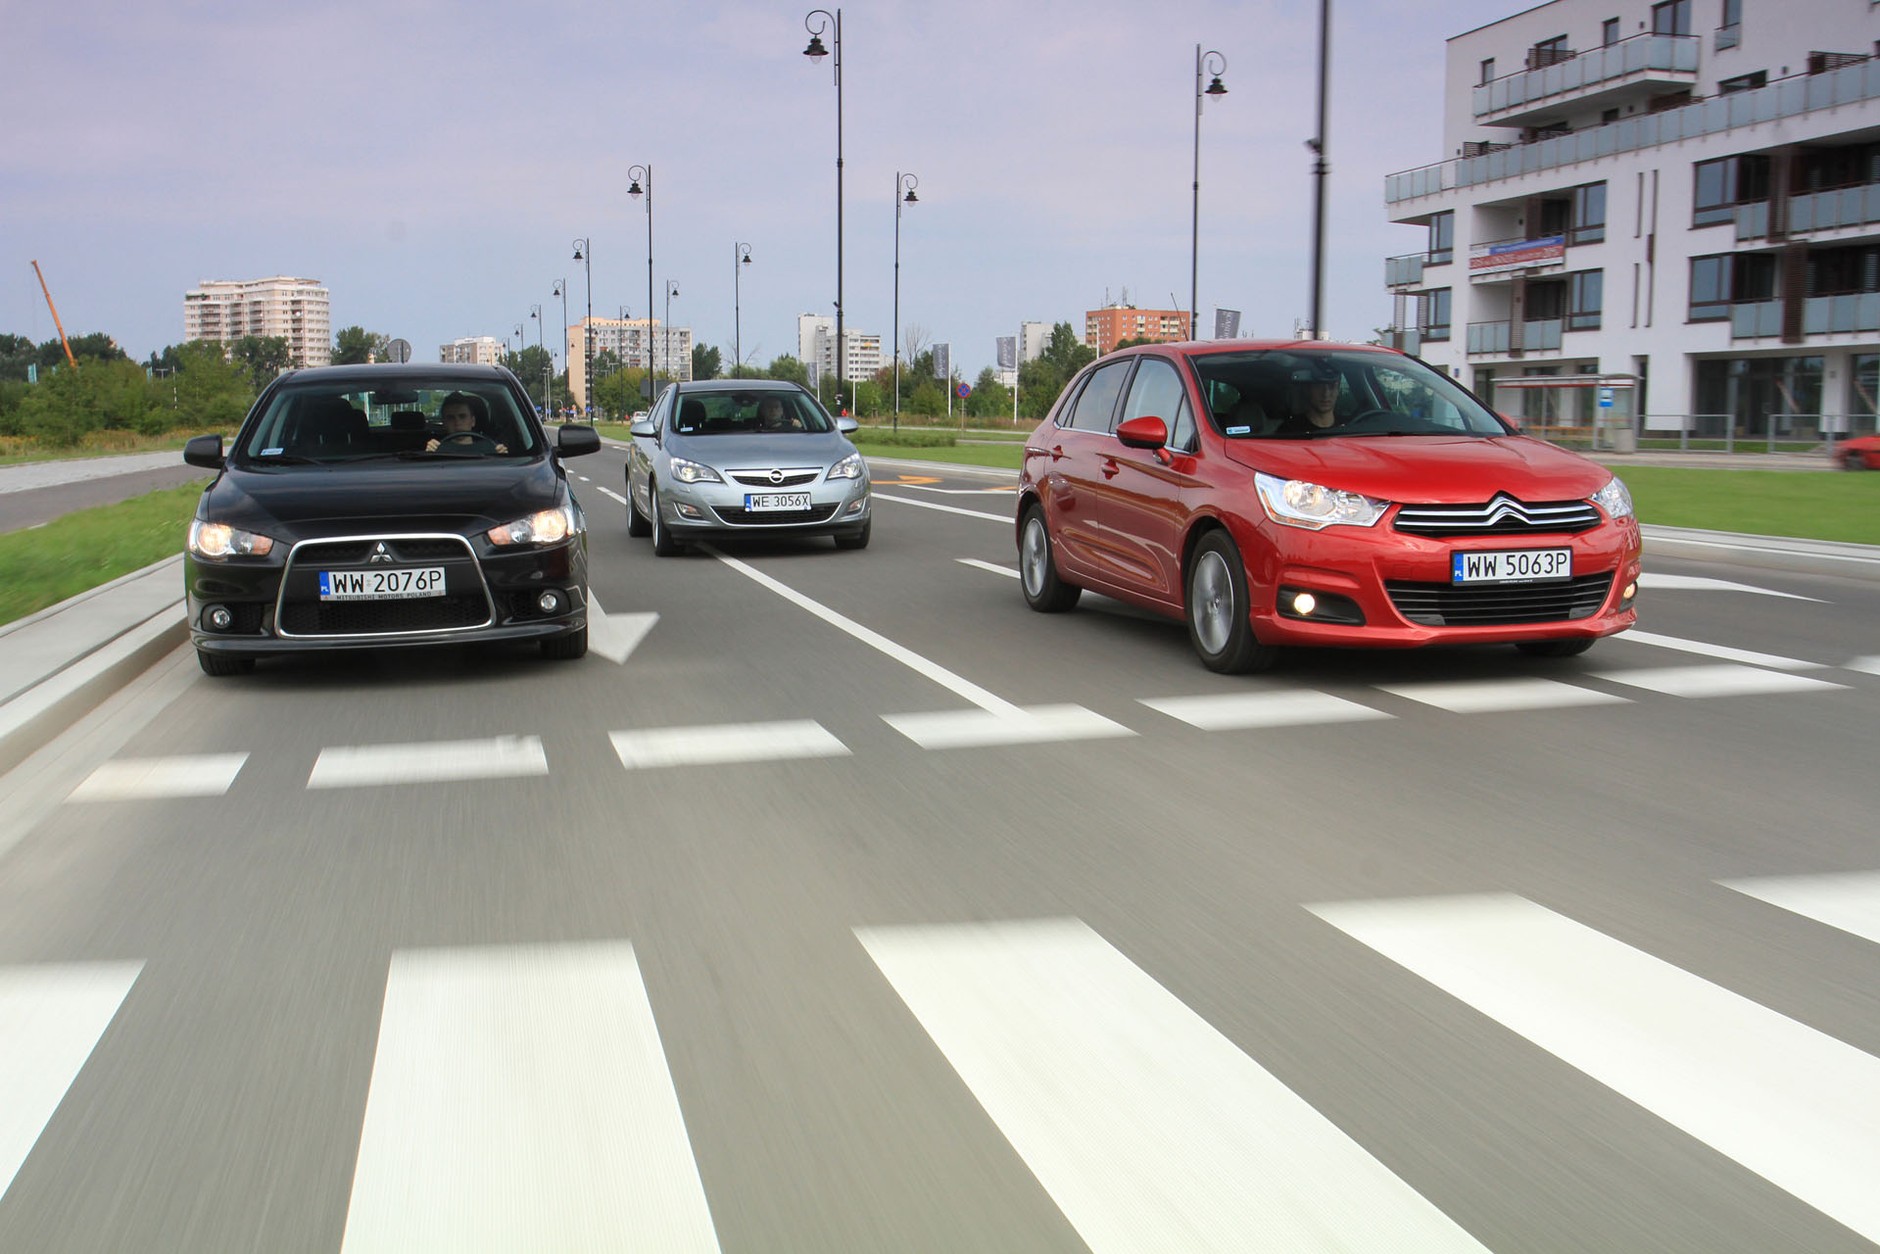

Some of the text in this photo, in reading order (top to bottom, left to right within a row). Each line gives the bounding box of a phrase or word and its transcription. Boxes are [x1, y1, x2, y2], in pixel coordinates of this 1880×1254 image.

[752, 496, 770, 508] WE
[774, 495, 809, 507] 3056X
[1467, 552, 1567, 578] WW 5063P
[332, 570, 442, 593] WW 2076P
